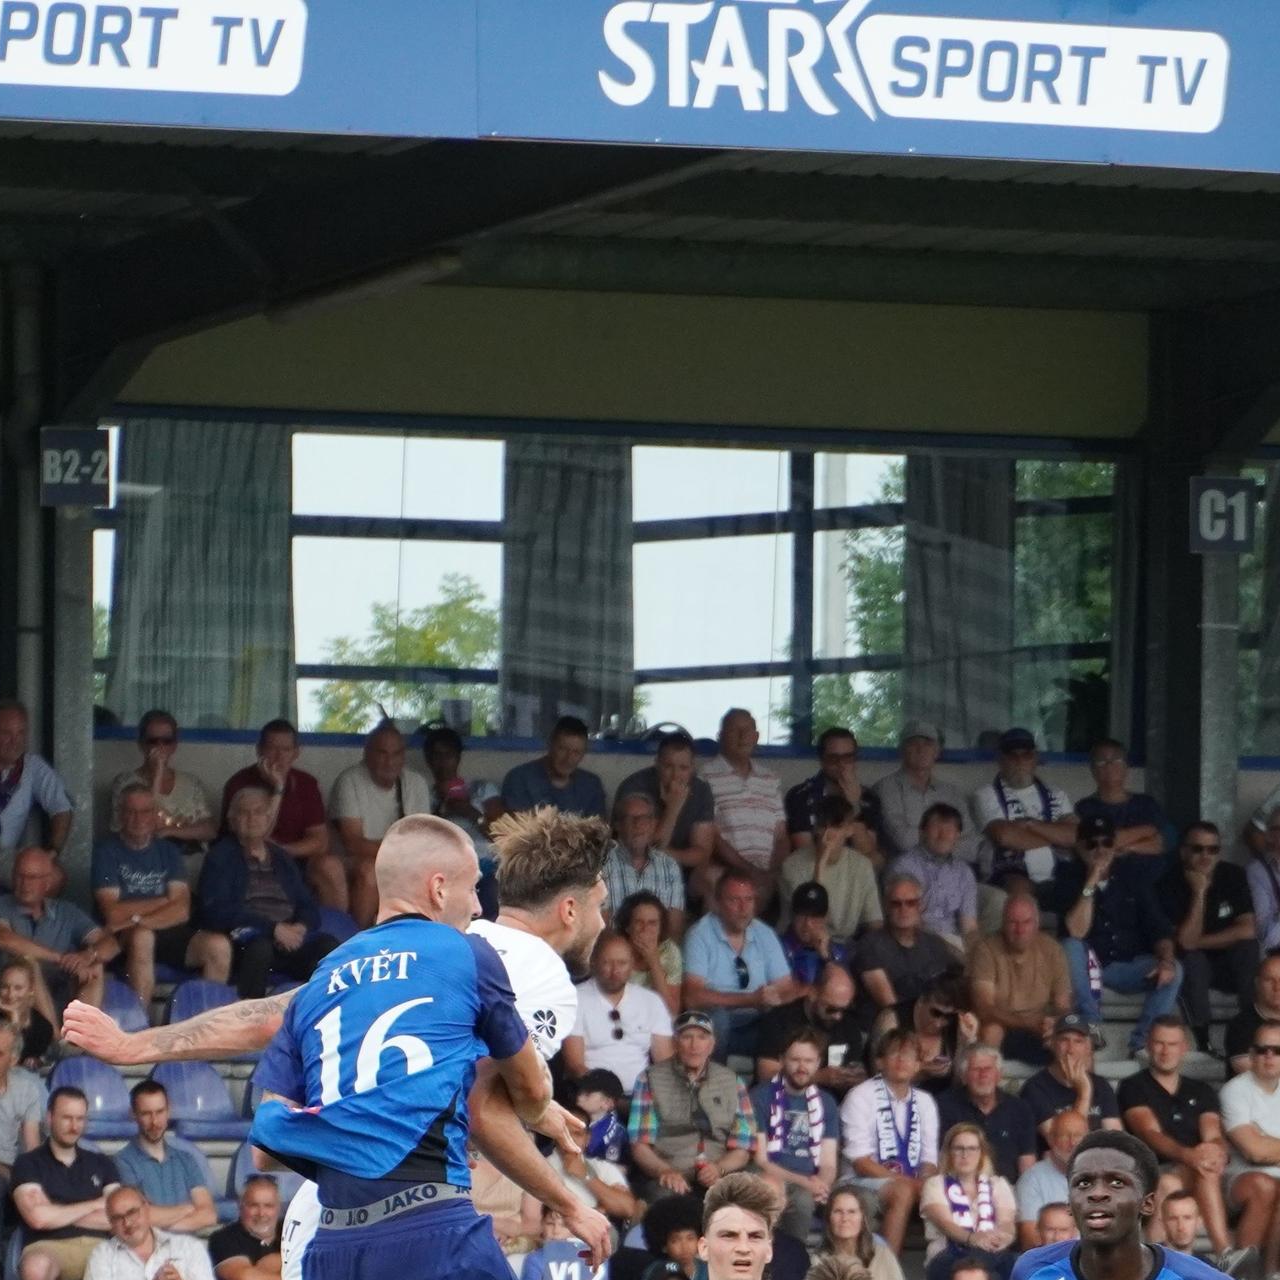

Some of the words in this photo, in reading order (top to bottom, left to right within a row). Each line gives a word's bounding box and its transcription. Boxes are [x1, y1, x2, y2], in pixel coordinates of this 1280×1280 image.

[211, 16, 286, 68] TV
[598, 0, 839, 116] STAR
[889, 36, 1107, 106] SPORT
[1138, 55, 1208, 107] TV
[42, 450, 109, 485] B2-2
[1199, 490, 1248, 542] C1
[327, 949, 417, 995] KVĚT
[314, 997, 434, 1107] 16
[382, 1184, 438, 1215] JAKO
